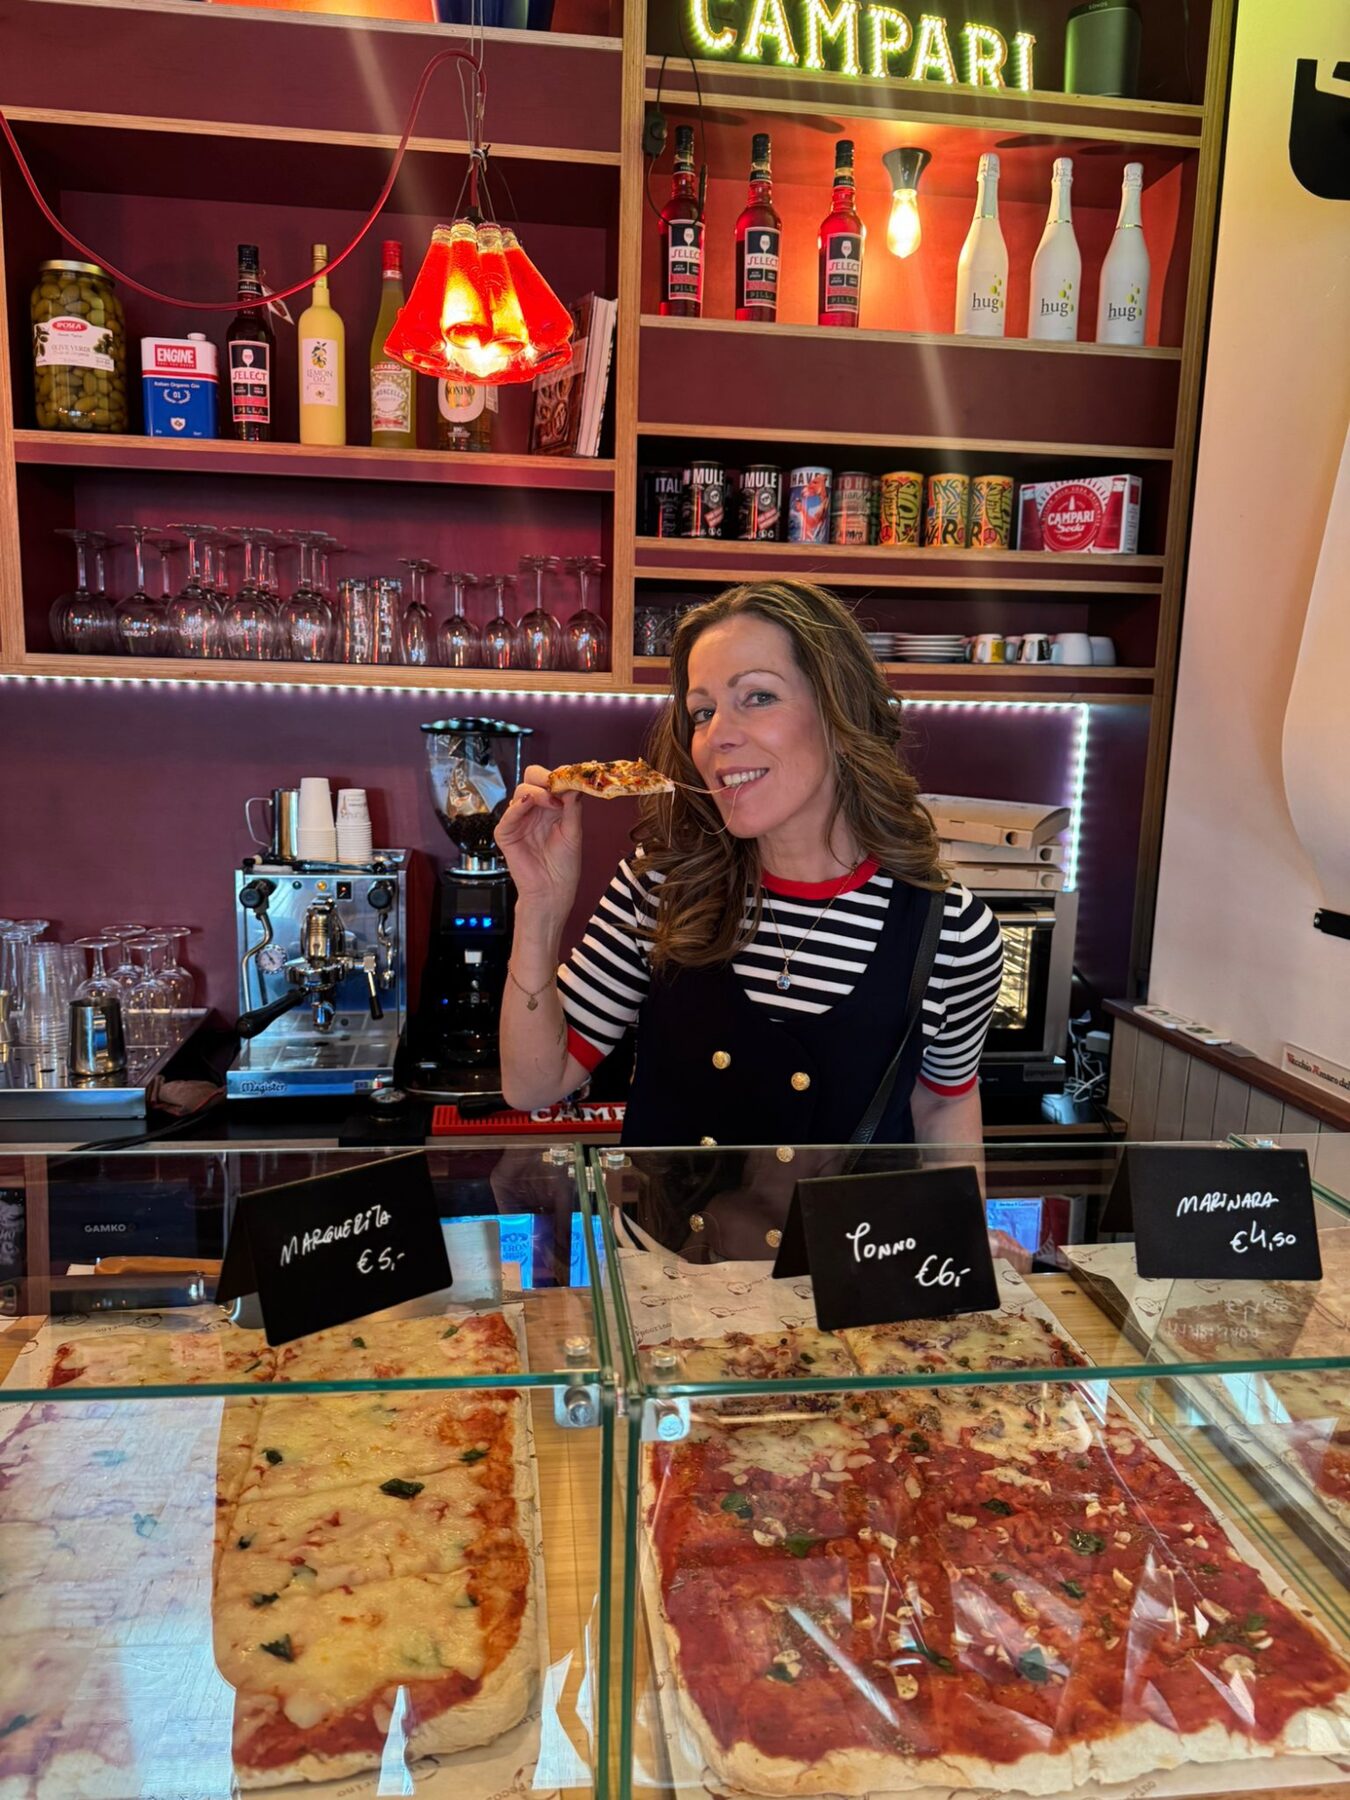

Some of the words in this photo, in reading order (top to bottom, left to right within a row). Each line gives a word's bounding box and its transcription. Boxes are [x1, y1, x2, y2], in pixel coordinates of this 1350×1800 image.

[686, 0, 1037, 92] CAMPARI
[829, 260, 860, 273] SELECT
[972, 292, 999, 314] hug
[1040, 298, 1069, 318] hug
[1108, 303, 1136, 322] hug
[157, 347, 195, 366] ENGINE
[232, 368, 268, 381] SELECT
[693, 468, 724, 486] MULE
[745, 472, 778, 488] MULE
[1047, 510, 1095, 526] CAMPARI
[1176, 1191, 1280, 1218] MARINARA
[84, 1223, 127, 1233] GAMKO
[1229, 1219, 1297, 1254] €4,50
